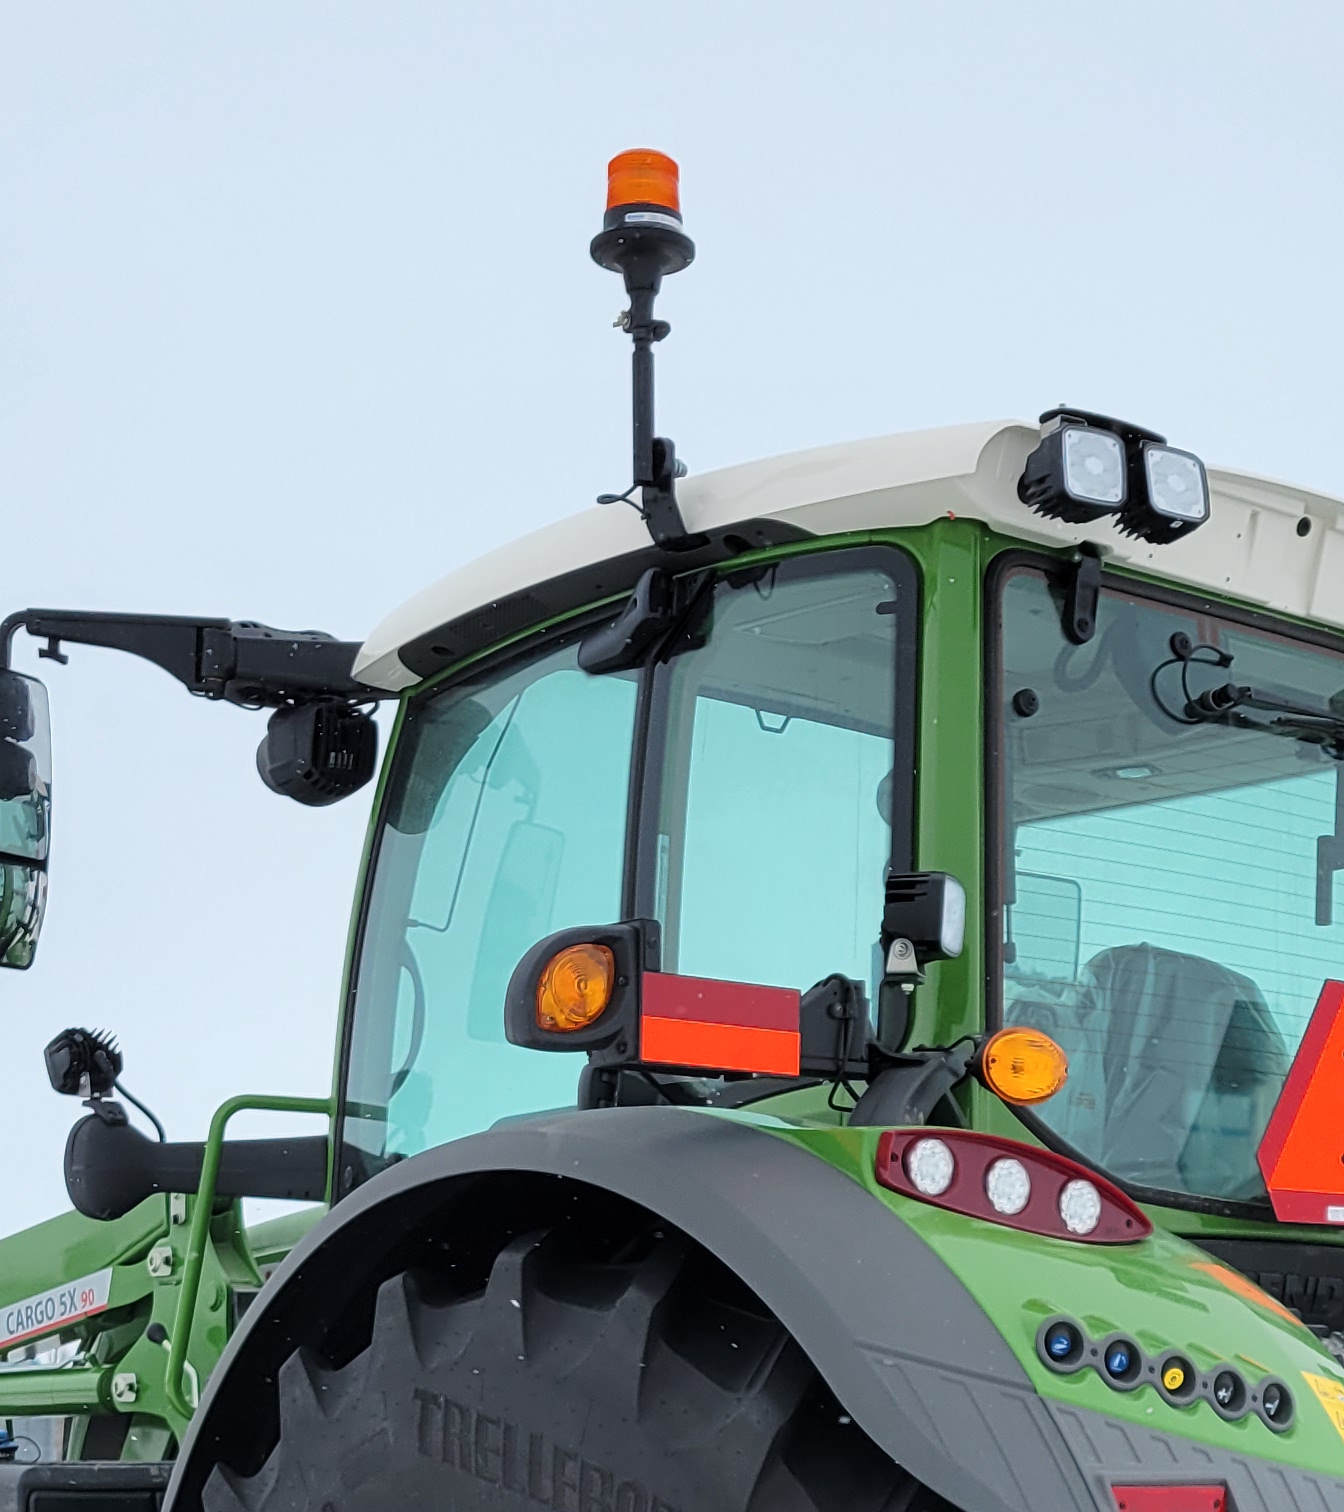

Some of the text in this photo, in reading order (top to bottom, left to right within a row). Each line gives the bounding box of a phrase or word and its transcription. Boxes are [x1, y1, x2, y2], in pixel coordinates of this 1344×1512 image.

[6, 1287, 95, 1335] CARGO 5X 90
